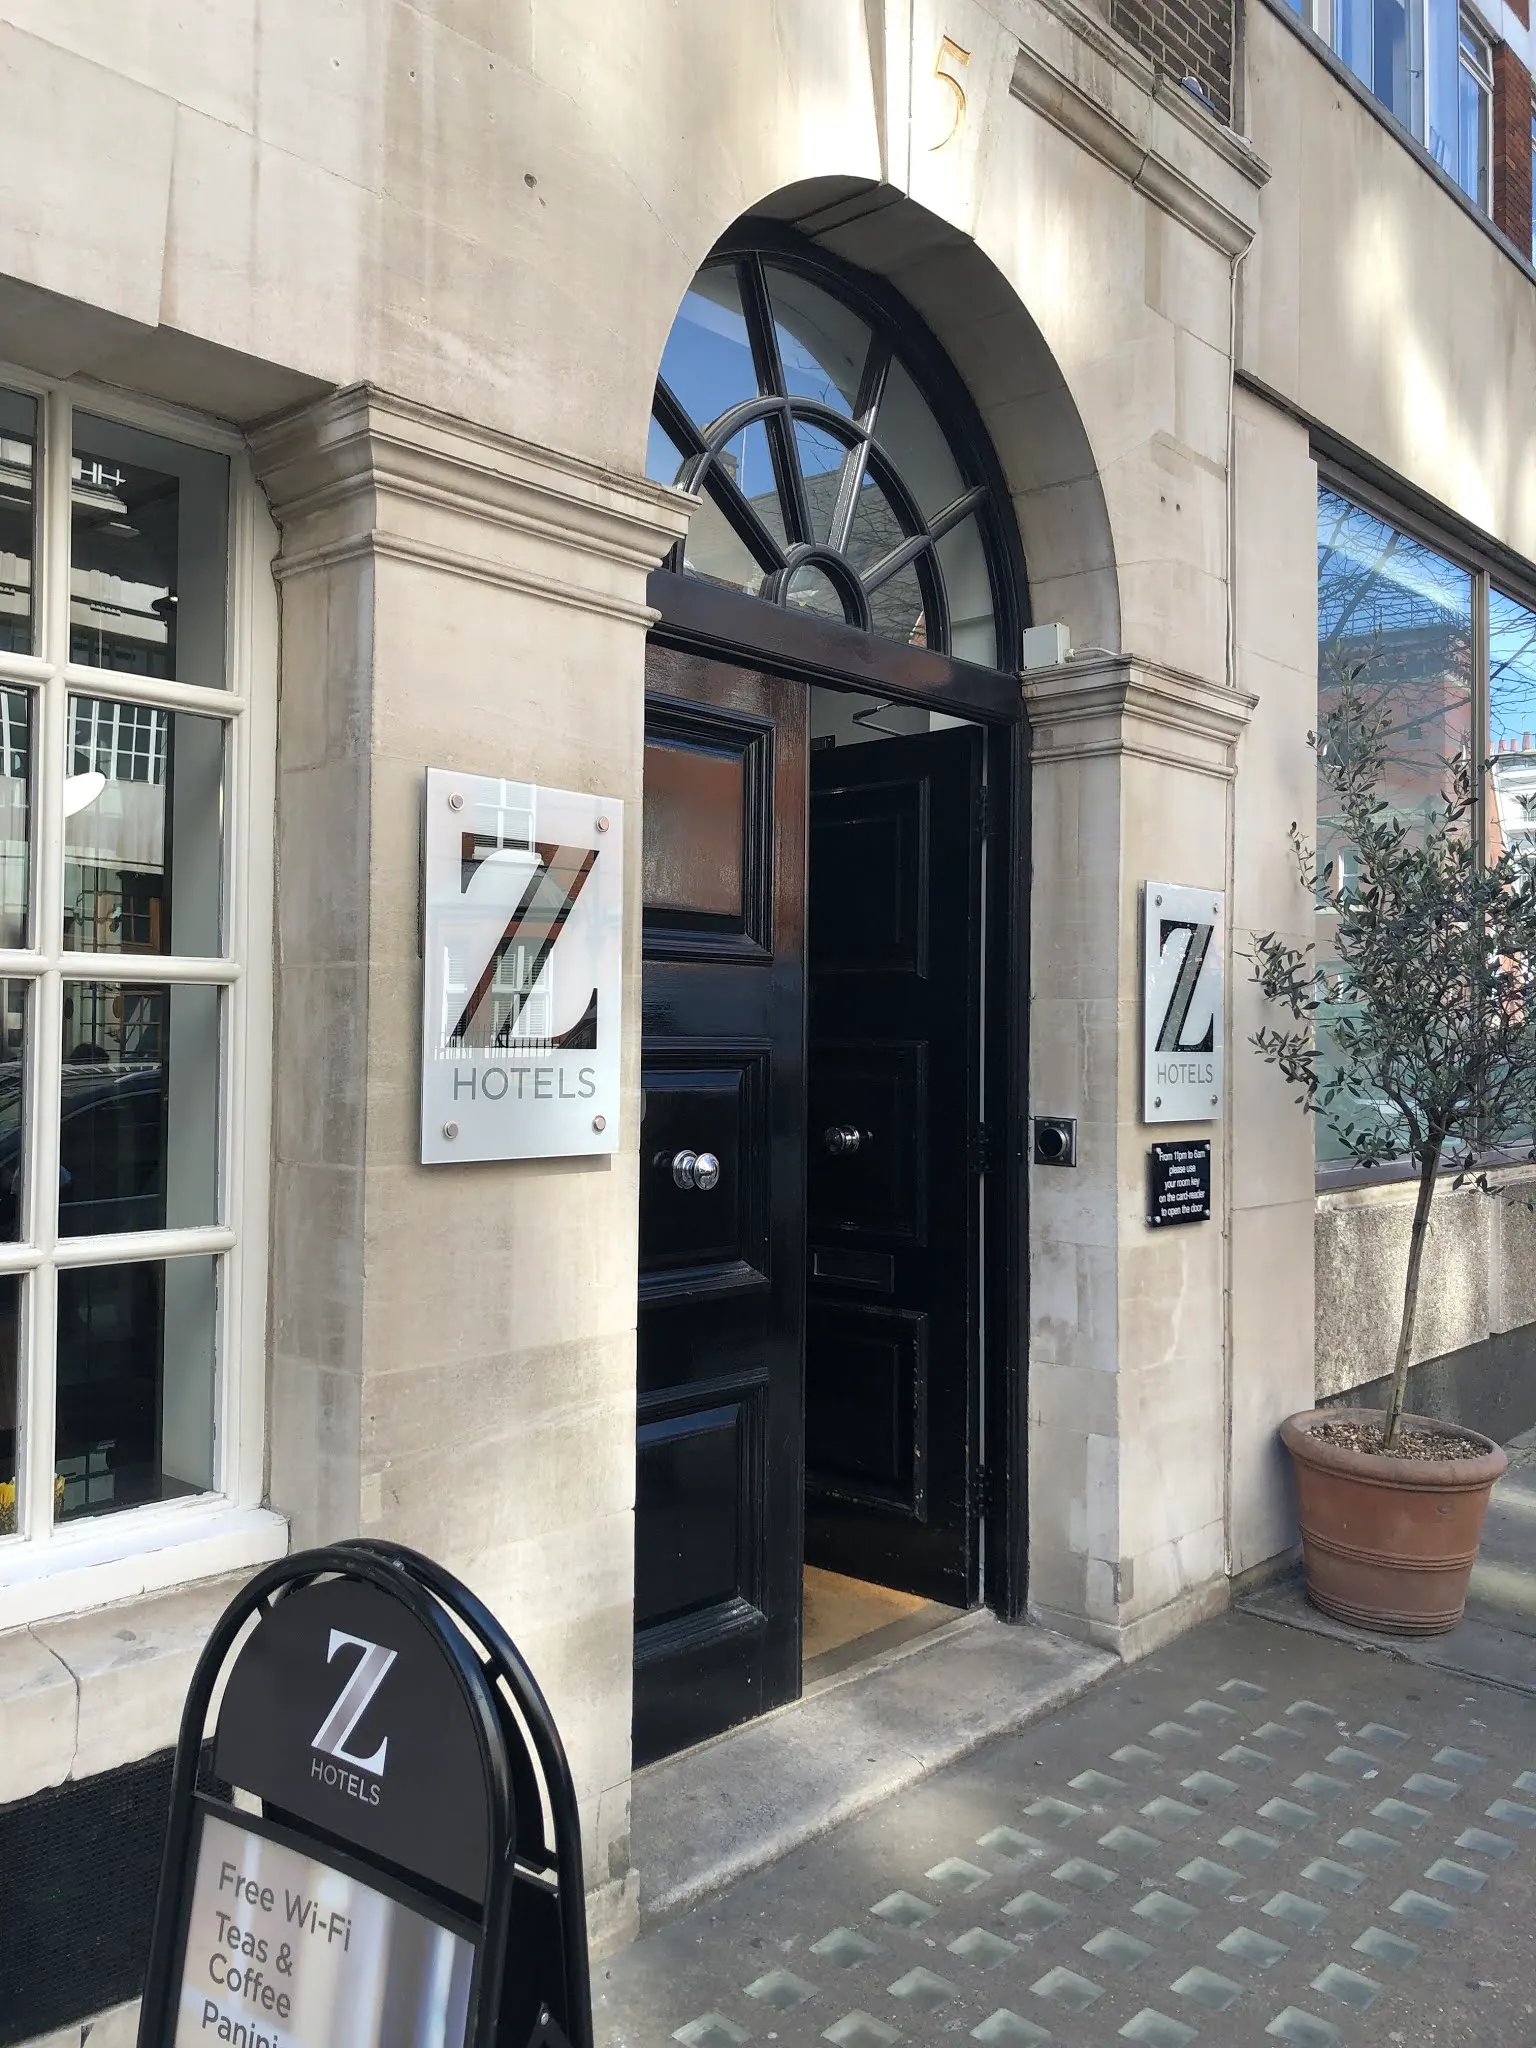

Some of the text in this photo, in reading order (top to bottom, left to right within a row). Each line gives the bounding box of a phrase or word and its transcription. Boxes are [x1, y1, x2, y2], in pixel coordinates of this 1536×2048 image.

[928, 35, 971, 151] 5
[445, 832, 600, 1049] Z
[1155, 919, 1214, 1052] Z
[453, 1067, 596, 1100] HOTELS
[1157, 1063, 1213, 1084] HOTELS
[1159, 1149, 1206, 1162] From 11pm to 6am
[1169, 1164, 1196, 1176] please use
[1159, 1190, 1206, 1203] on the card-reader
[1164, 1176, 1200, 1191] your room key
[1161, 1203, 1203, 1217] to open the door
[311, 1628, 398, 1776] Z
[311, 1757, 381, 1806] HOTELS
[219, 1861, 351, 1952] Free Wi-Fi
[216, 1910, 293, 1977] Teas &
[209, 1952, 291, 2018] Coffee
